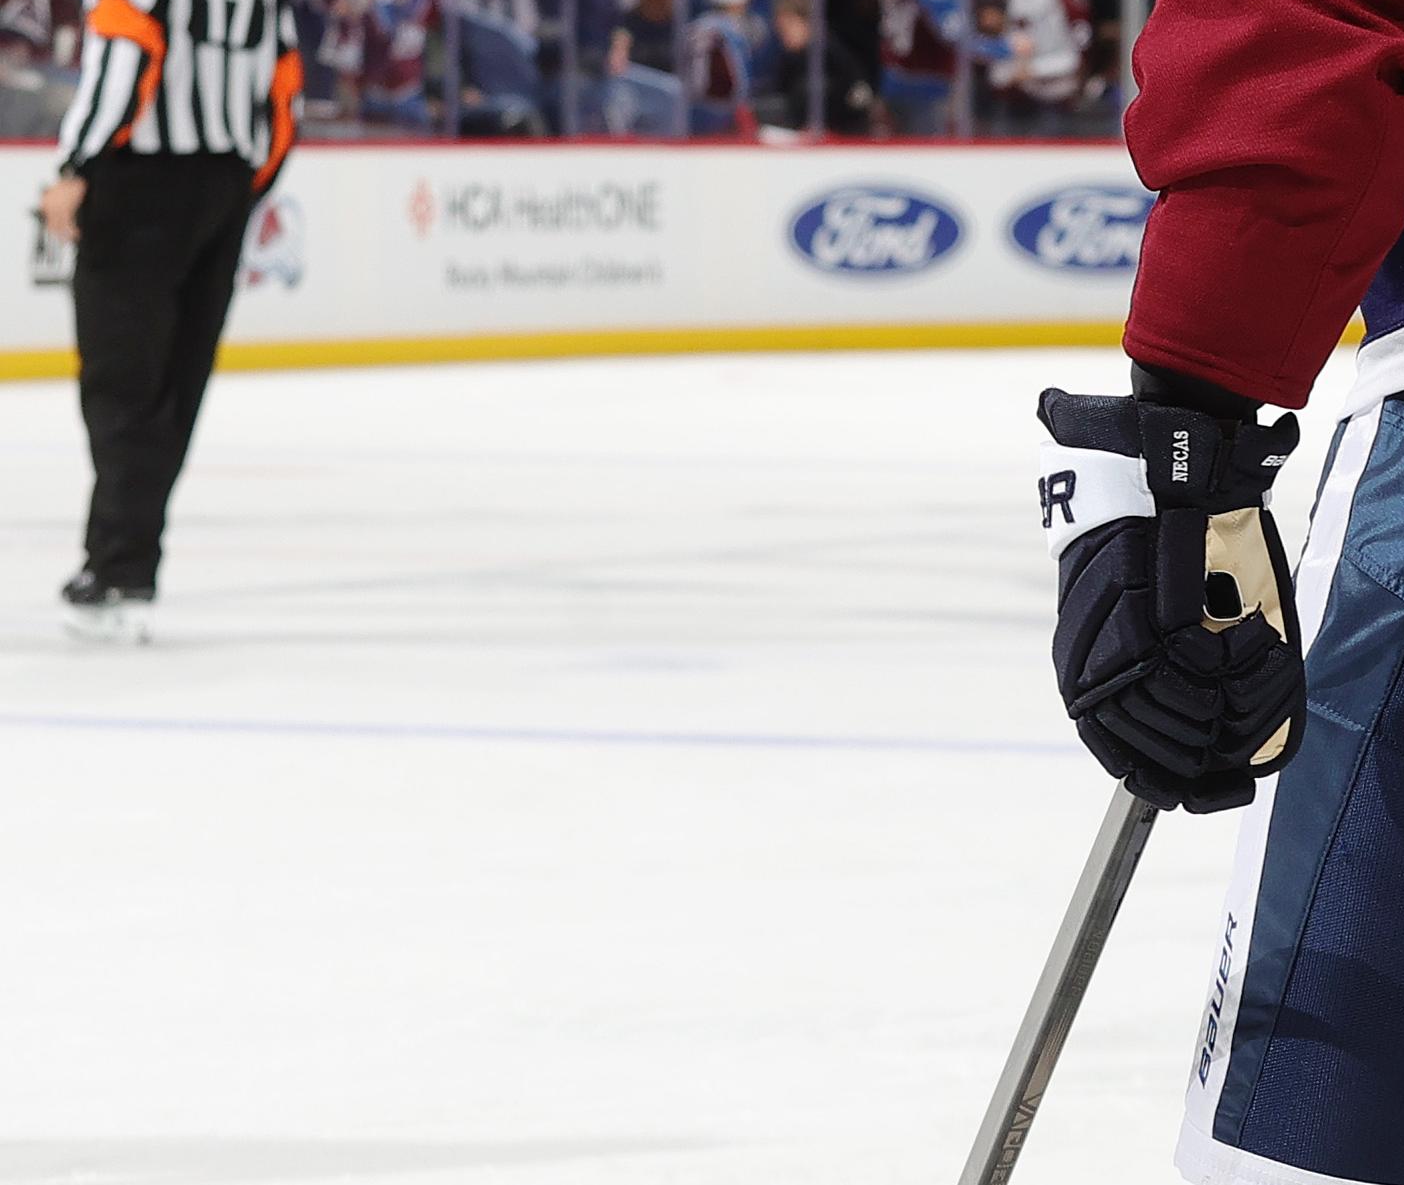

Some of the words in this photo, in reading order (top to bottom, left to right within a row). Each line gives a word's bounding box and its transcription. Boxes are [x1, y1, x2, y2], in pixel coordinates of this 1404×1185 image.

[811, 192, 939, 270] Ford
[1172, 430, 1190, 482] NECAS
[1198, 911, 1237, 1089] BAUER
